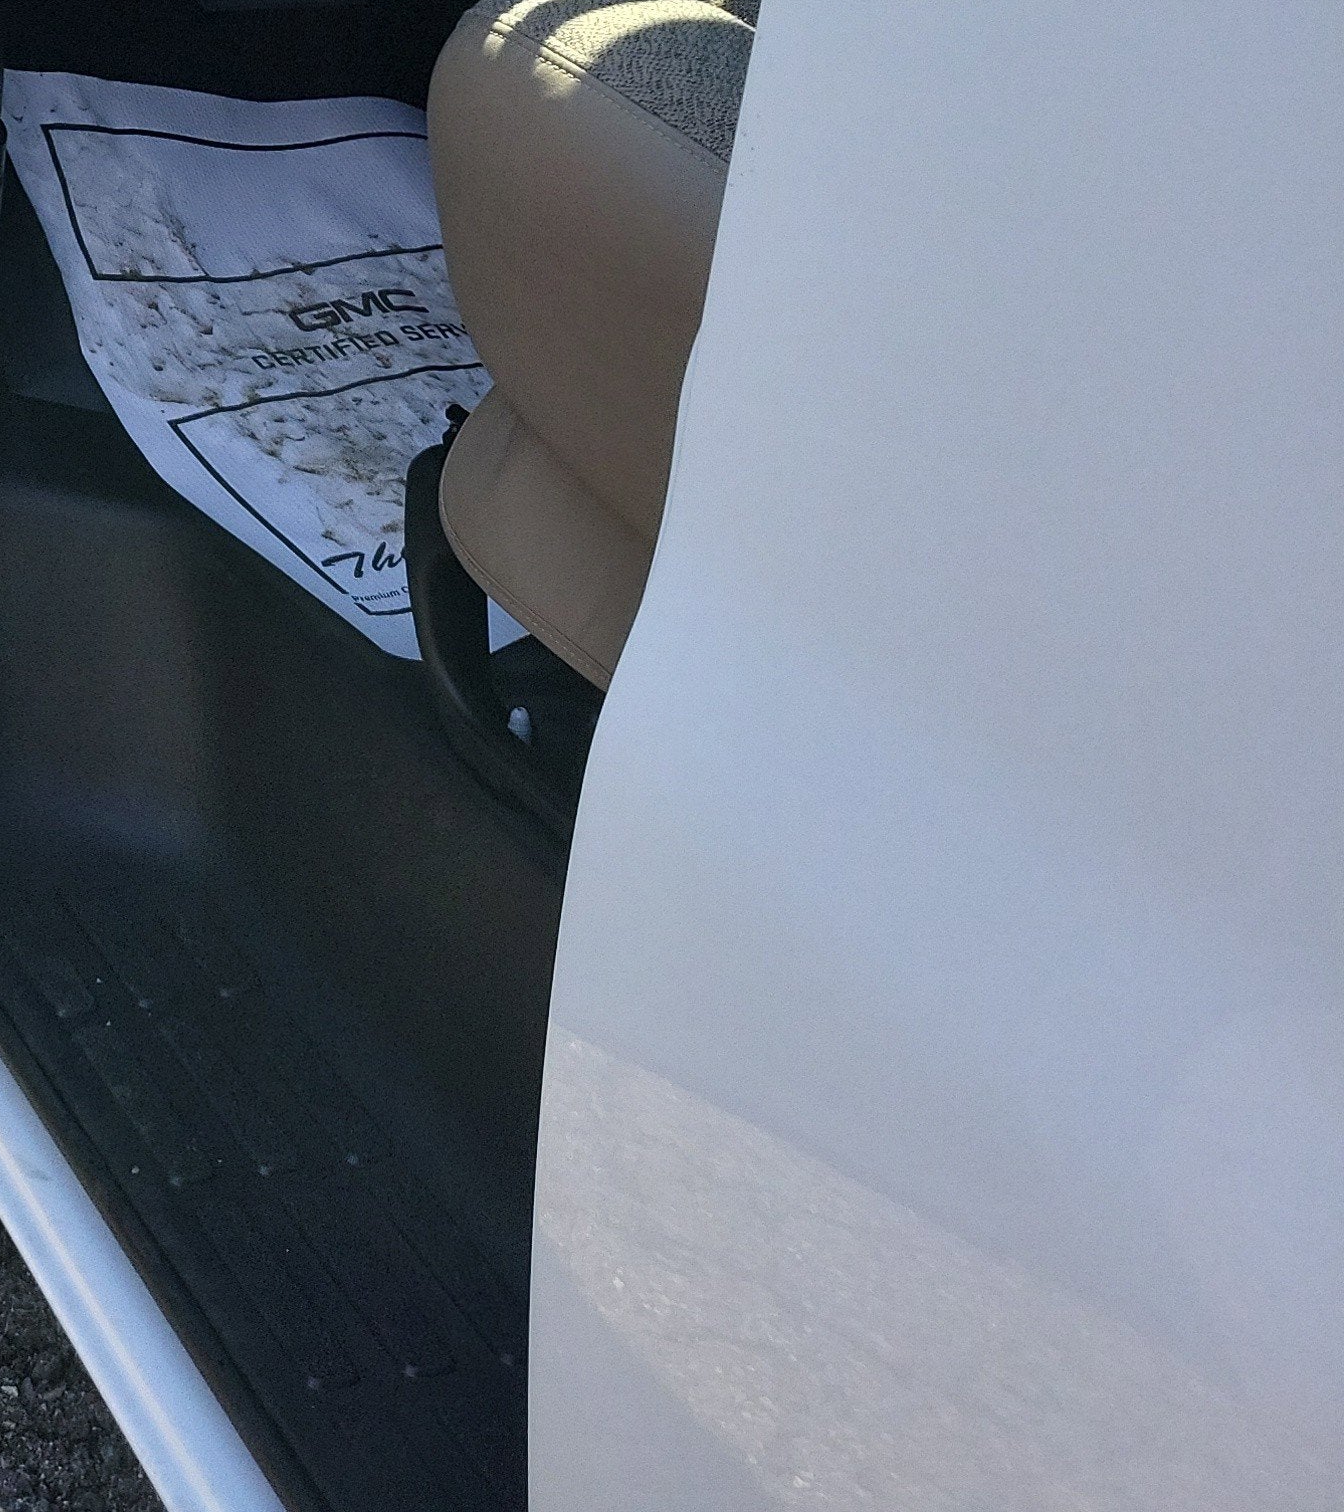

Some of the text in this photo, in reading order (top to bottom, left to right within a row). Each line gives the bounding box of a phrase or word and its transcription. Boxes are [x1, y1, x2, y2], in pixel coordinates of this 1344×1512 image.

[288, 288, 430, 332] GMC
[251, 330, 400, 370] CERTIFIED
[351, 589, 401, 602] Premium
